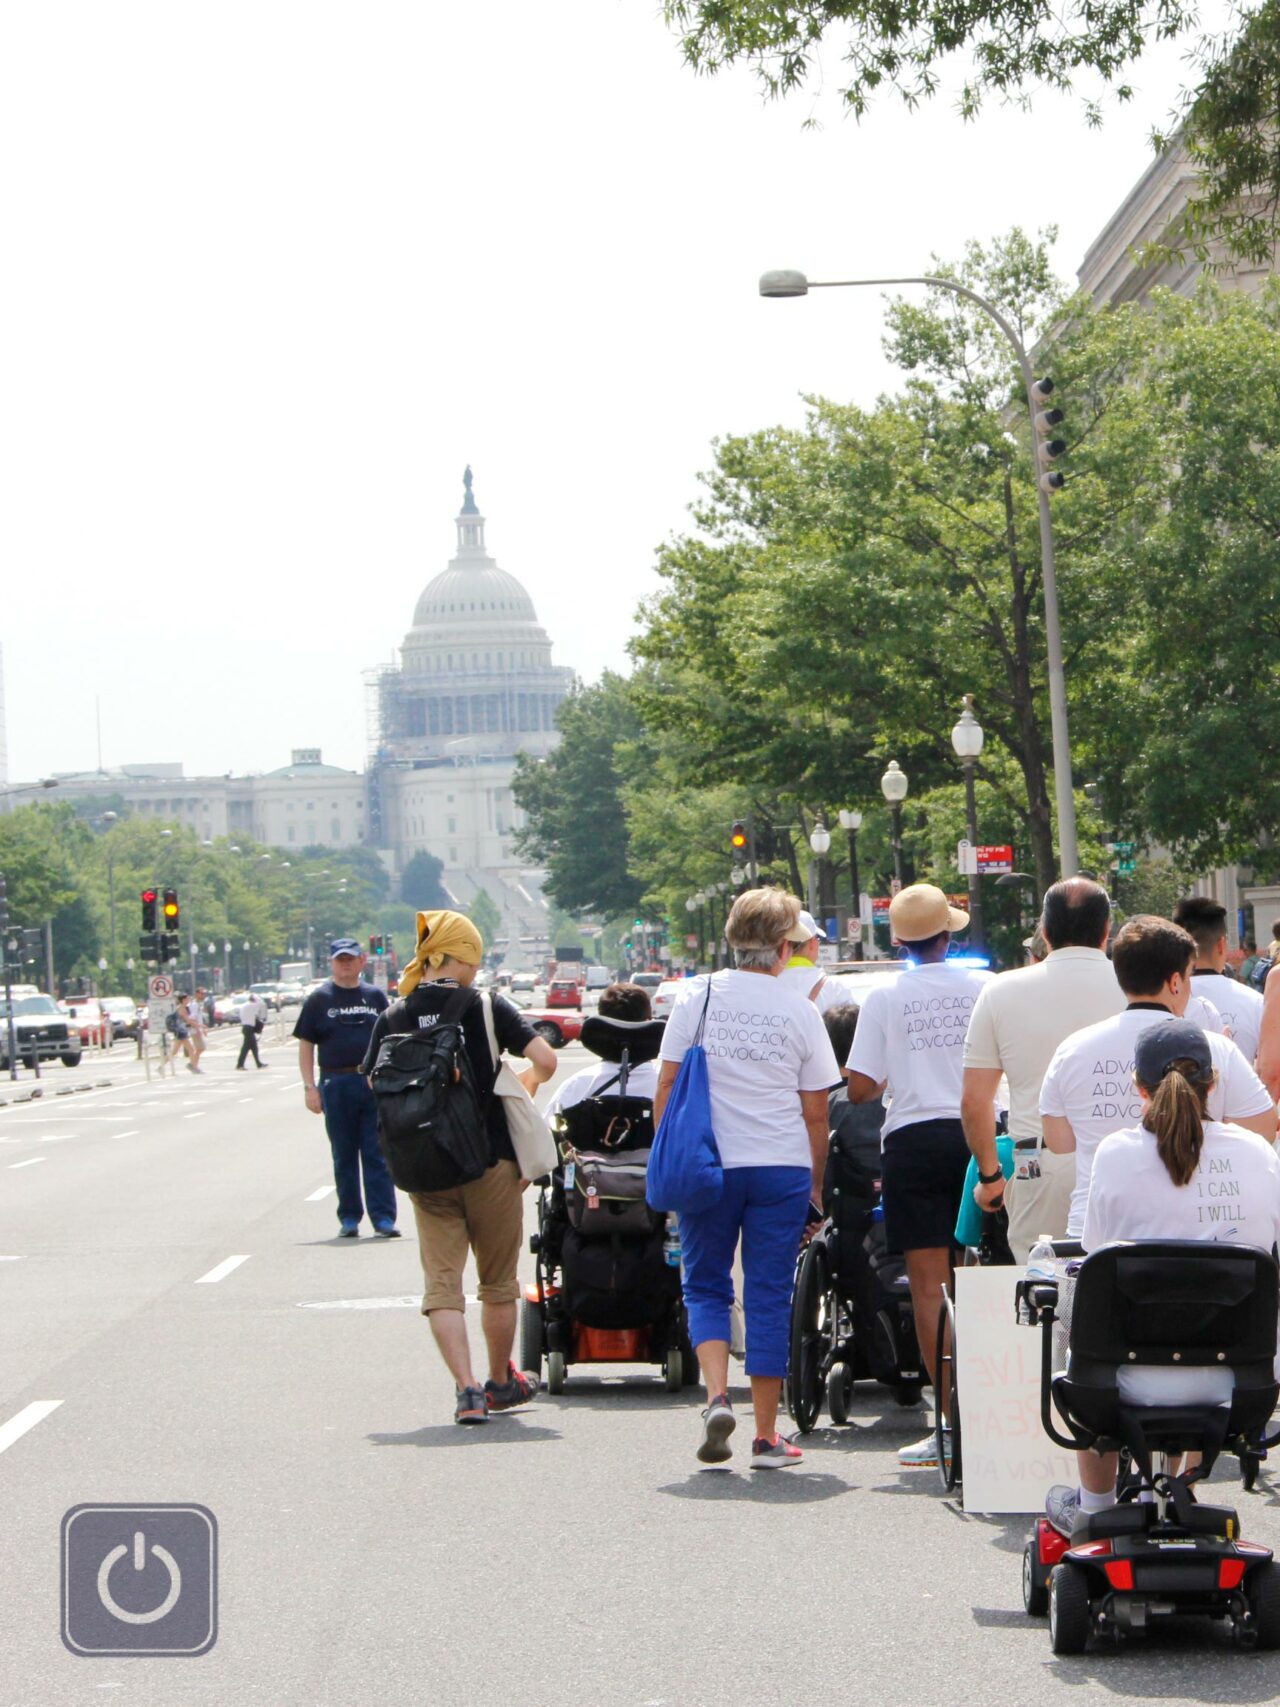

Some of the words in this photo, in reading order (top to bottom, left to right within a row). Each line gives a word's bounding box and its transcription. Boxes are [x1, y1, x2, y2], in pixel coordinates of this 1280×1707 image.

[340, 1006, 379, 1017] MARSHAL
[709, 1010, 790, 1028] ADVOCACY
[907, 1015, 971, 1034] ADVOCAC
[708, 1027, 788, 1046] ADVOCACY
[910, 1033, 967, 1052] ADVOCA
[706, 1044, 786, 1063] ADVOCACY
[1091, 1103, 1143, 1119] ADVO
[1208, 1158, 1233, 1174] AM
[1207, 1180, 1241, 1198] CAN
[1207, 1204, 1246, 1222] WILL
